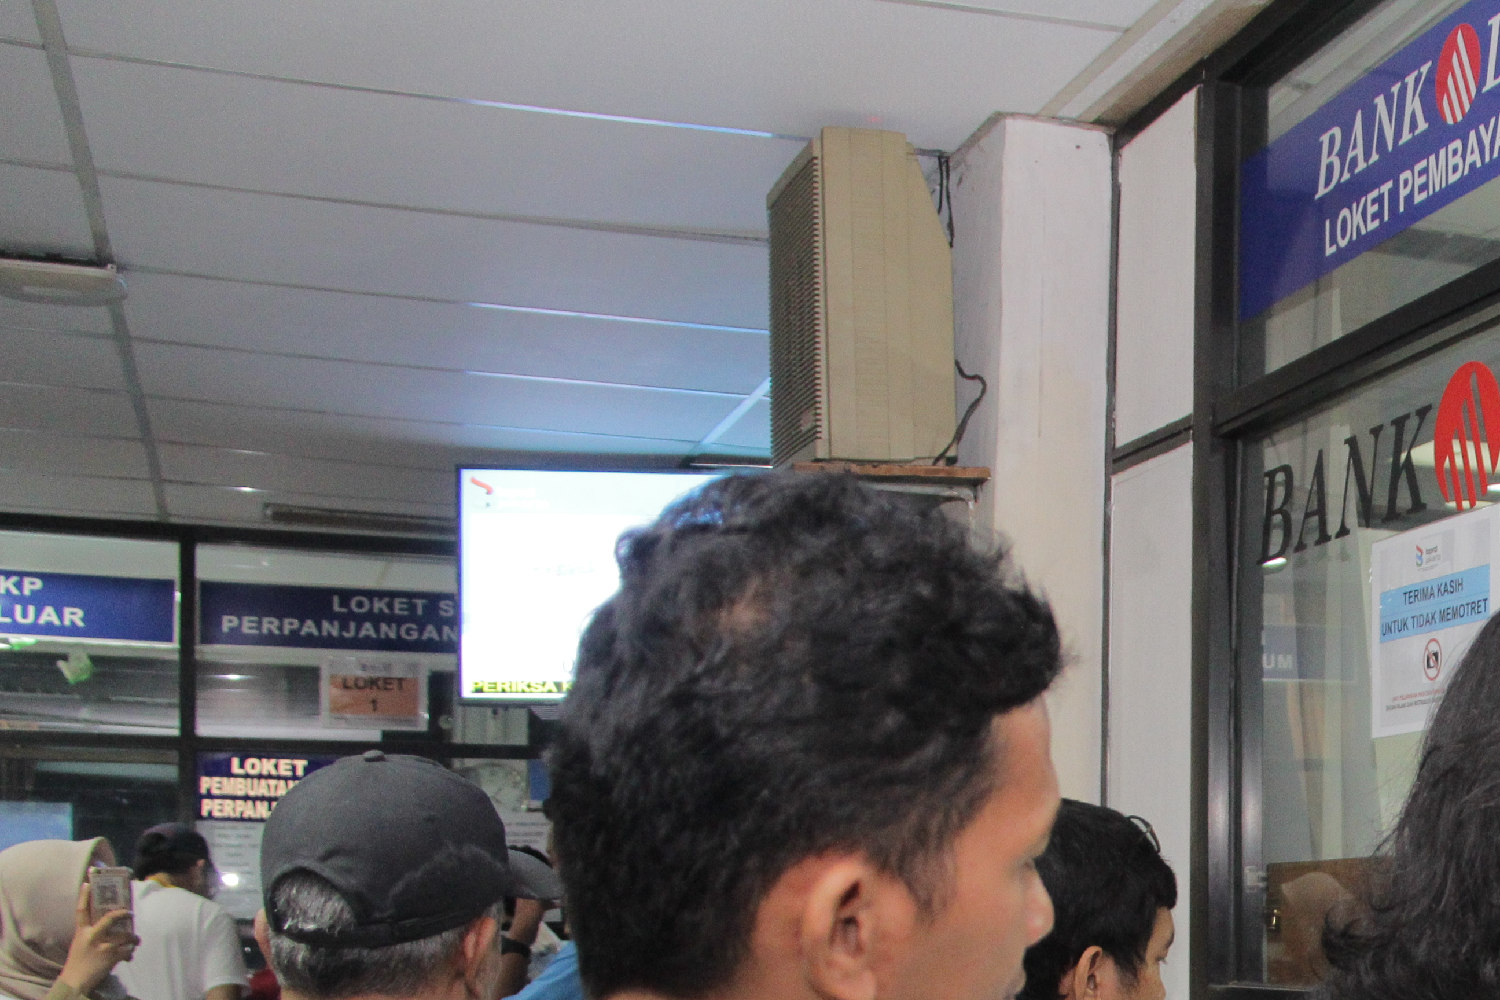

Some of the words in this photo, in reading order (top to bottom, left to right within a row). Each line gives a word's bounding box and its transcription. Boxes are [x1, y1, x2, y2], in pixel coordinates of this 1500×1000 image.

[1314, 60, 1433, 200] BANK
[1324, 180, 1393, 257] LOKET
[1256, 404, 1433, 566] BANK
[331, 594, 428, 616] LOKET
[438, 600, 455, 617] S
[1402, 585, 1436, 606] TERIMA
[1437, 577, 1464, 598] KASIH
[221, 615, 458, 643] PERPANJANGAN
[1381, 616, 1409, 637] UNTUK
[1411, 611, 1437, 630] TIDAK
[1438, 598, 1489, 623] MEMOTRET
[342, 675, 406, 691] LOKET
[471, 680, 559, 694] PERIKSA
[369, 698, 379, 713] 1
[230, 757, 309, 778] LOKET
